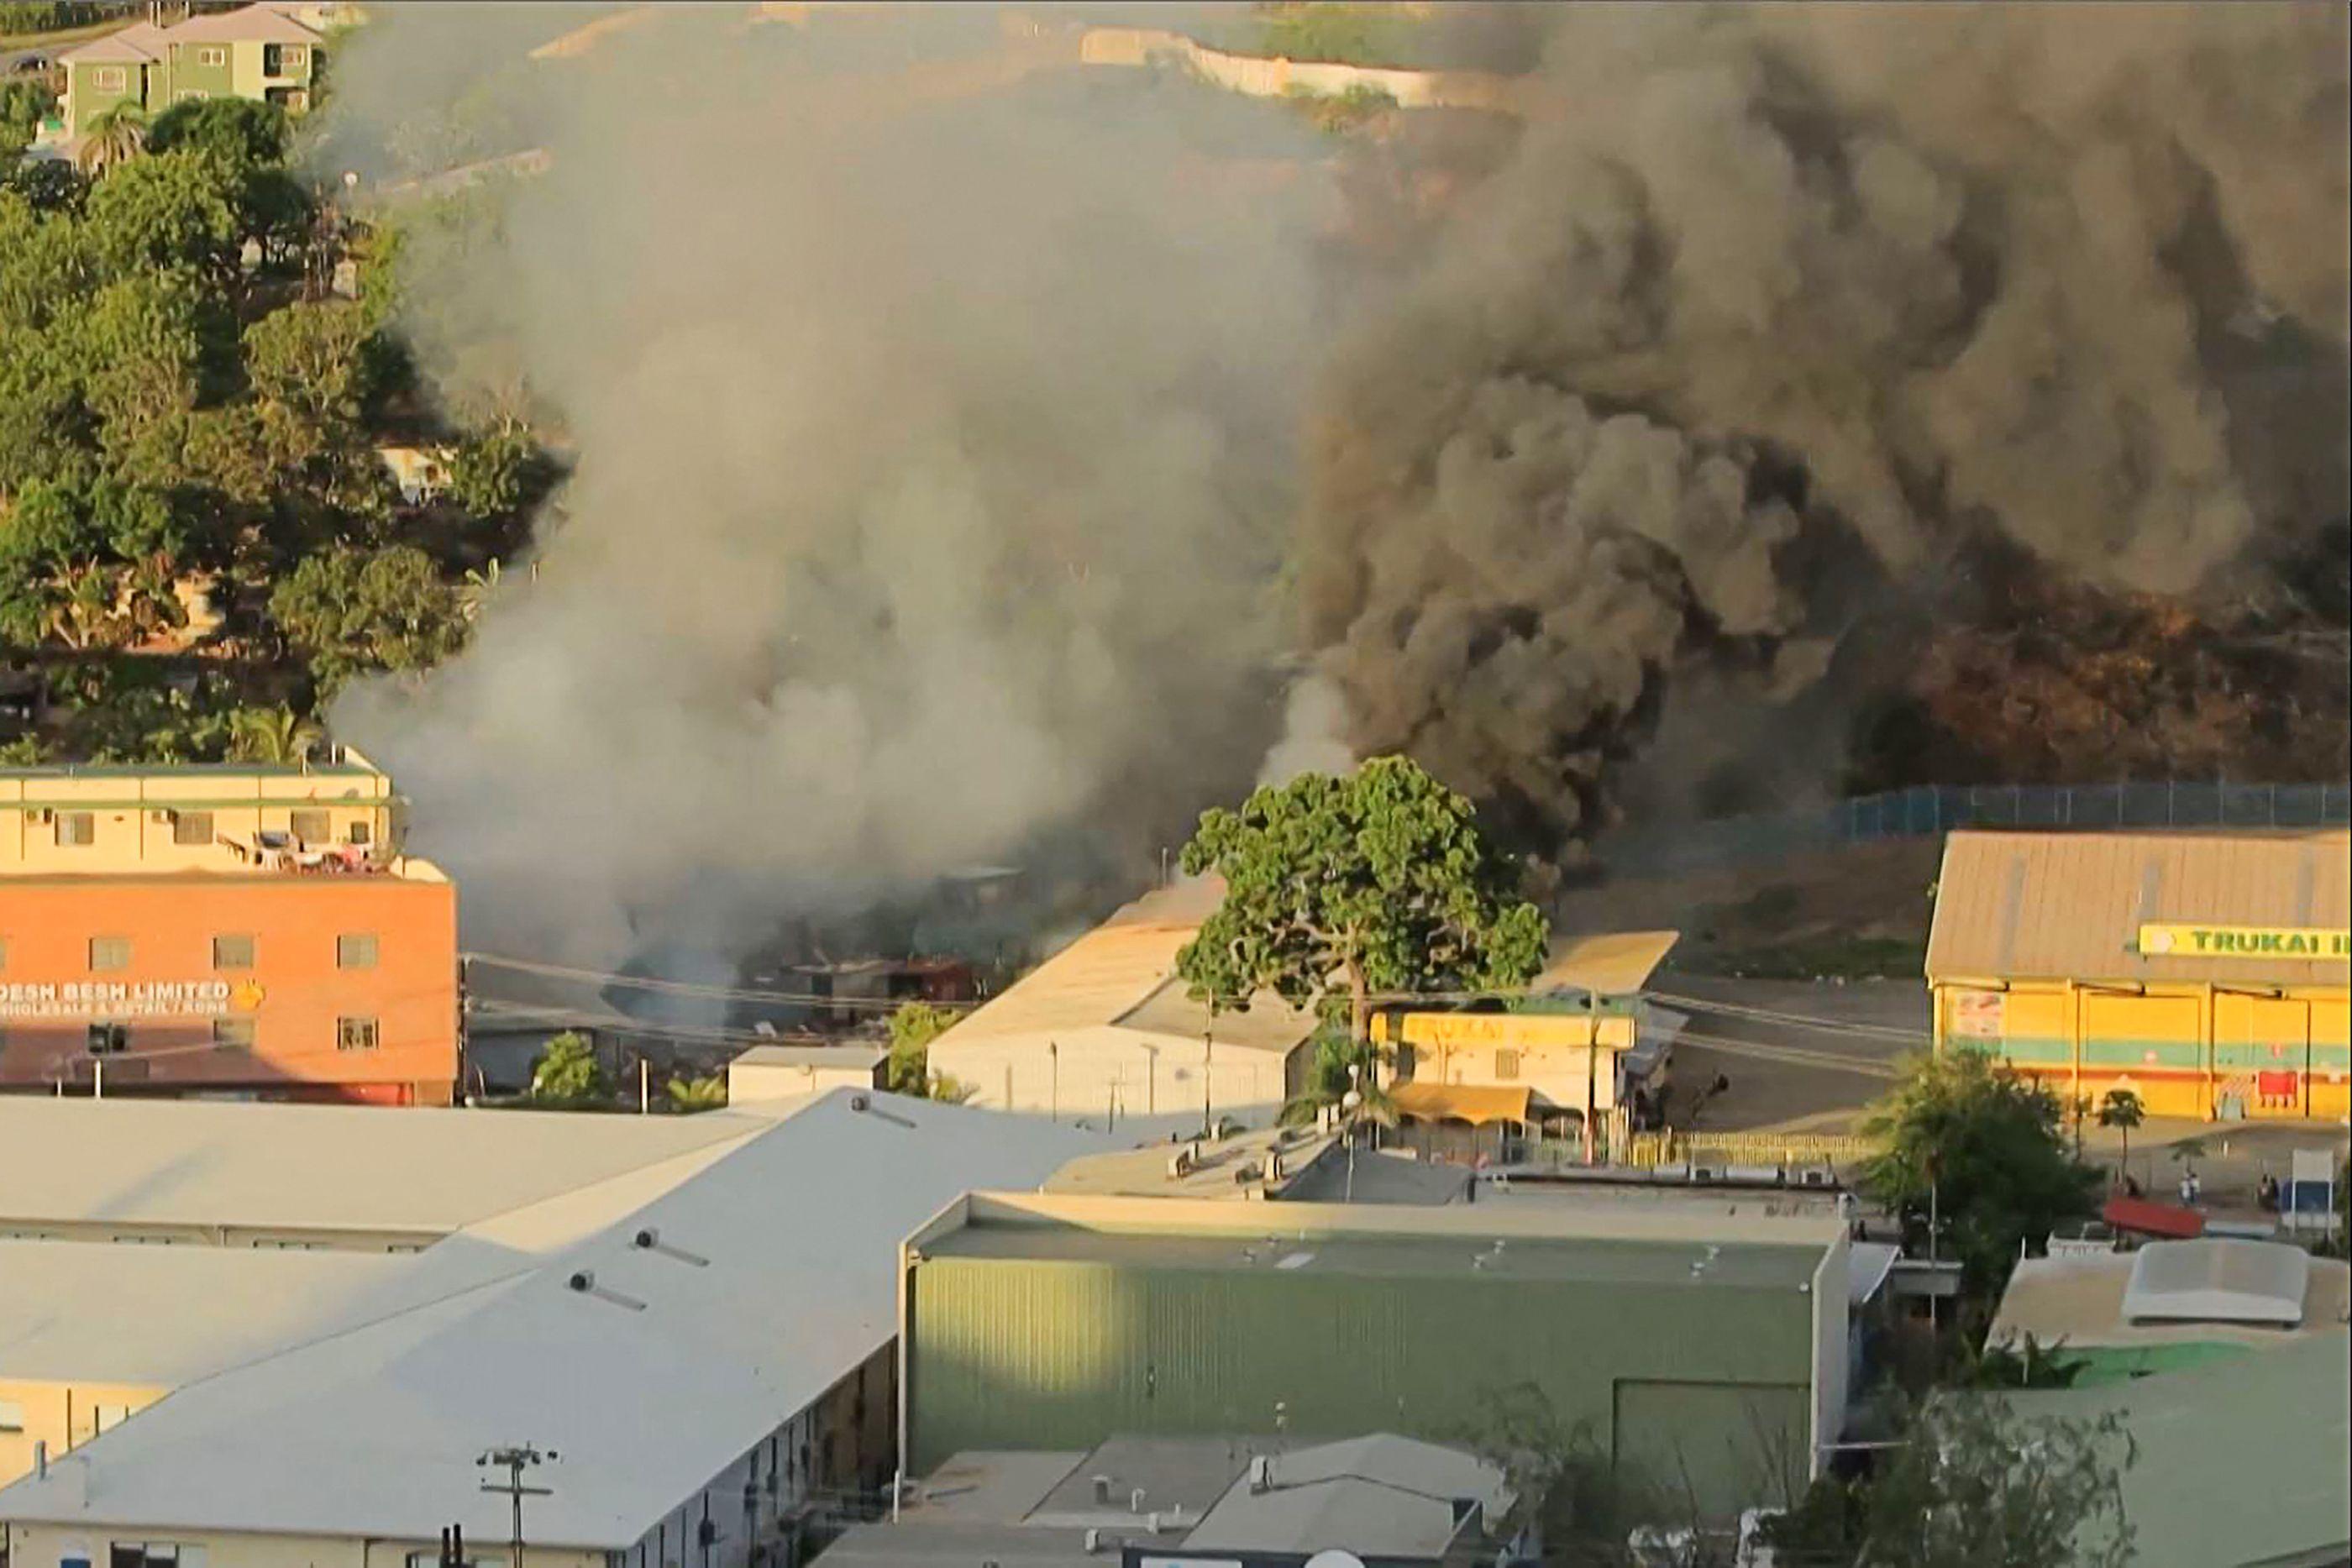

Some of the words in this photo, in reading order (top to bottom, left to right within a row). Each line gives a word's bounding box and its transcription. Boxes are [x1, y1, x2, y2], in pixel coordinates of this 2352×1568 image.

[2191, 931, 2320, 954] TRUKAI
[63, 983, 125, 1001] BESH
[134, 981, 228, 1000] LIMITED
